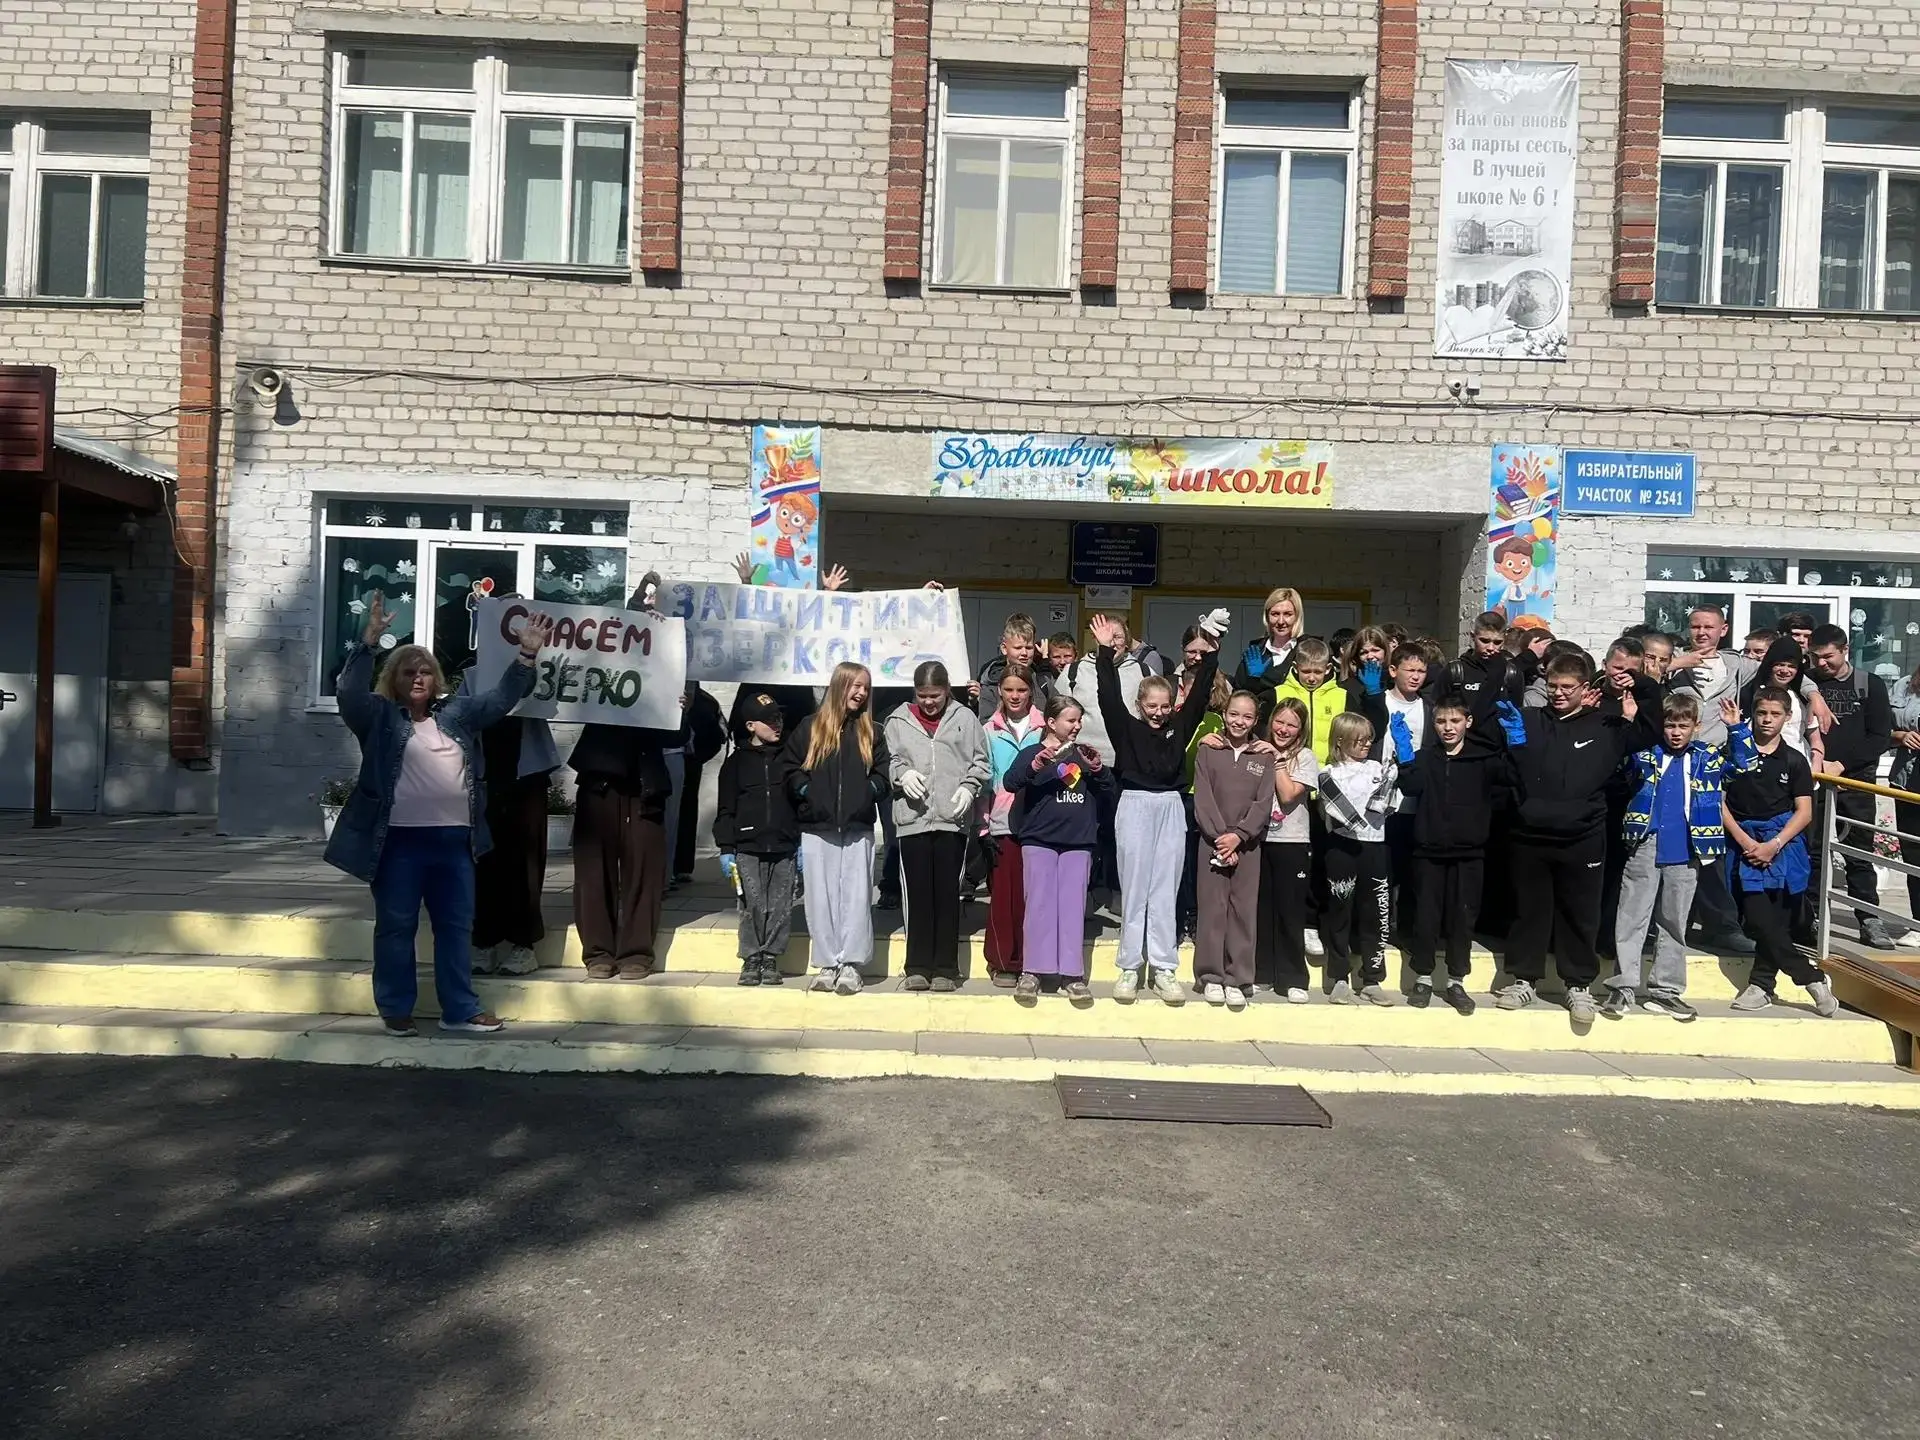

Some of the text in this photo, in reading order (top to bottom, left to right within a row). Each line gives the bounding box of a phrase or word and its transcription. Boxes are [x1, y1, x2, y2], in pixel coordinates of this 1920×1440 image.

[1455, 108, 1568, 128] Нам бы вновь
[1448, 137, 1572, 156] за парты сесть,
[1473, 159, 1546, 180] В лучшей
[1457, 190, 1503, 205] школе
[1509, 187, 1527, 206] №
[1533, 185, 1545, 207] 6
[938, 436, 1116, 480] Здравствуй,
[1168, 462, 1328, 495] школа!
[1577, 462, 1684, 481] ИЗБИРАТЕЛЬНЫЙ
[1577, 486, 1683, 505] УЧАСТОК № 2541
[571, 574, 584, 591] 5
[672, 583, 948, 632] ЗАЩИТИМ
[523, 660, 642, 708] ЗЕРКО
[1056, 790, 1085, 803] Likee
